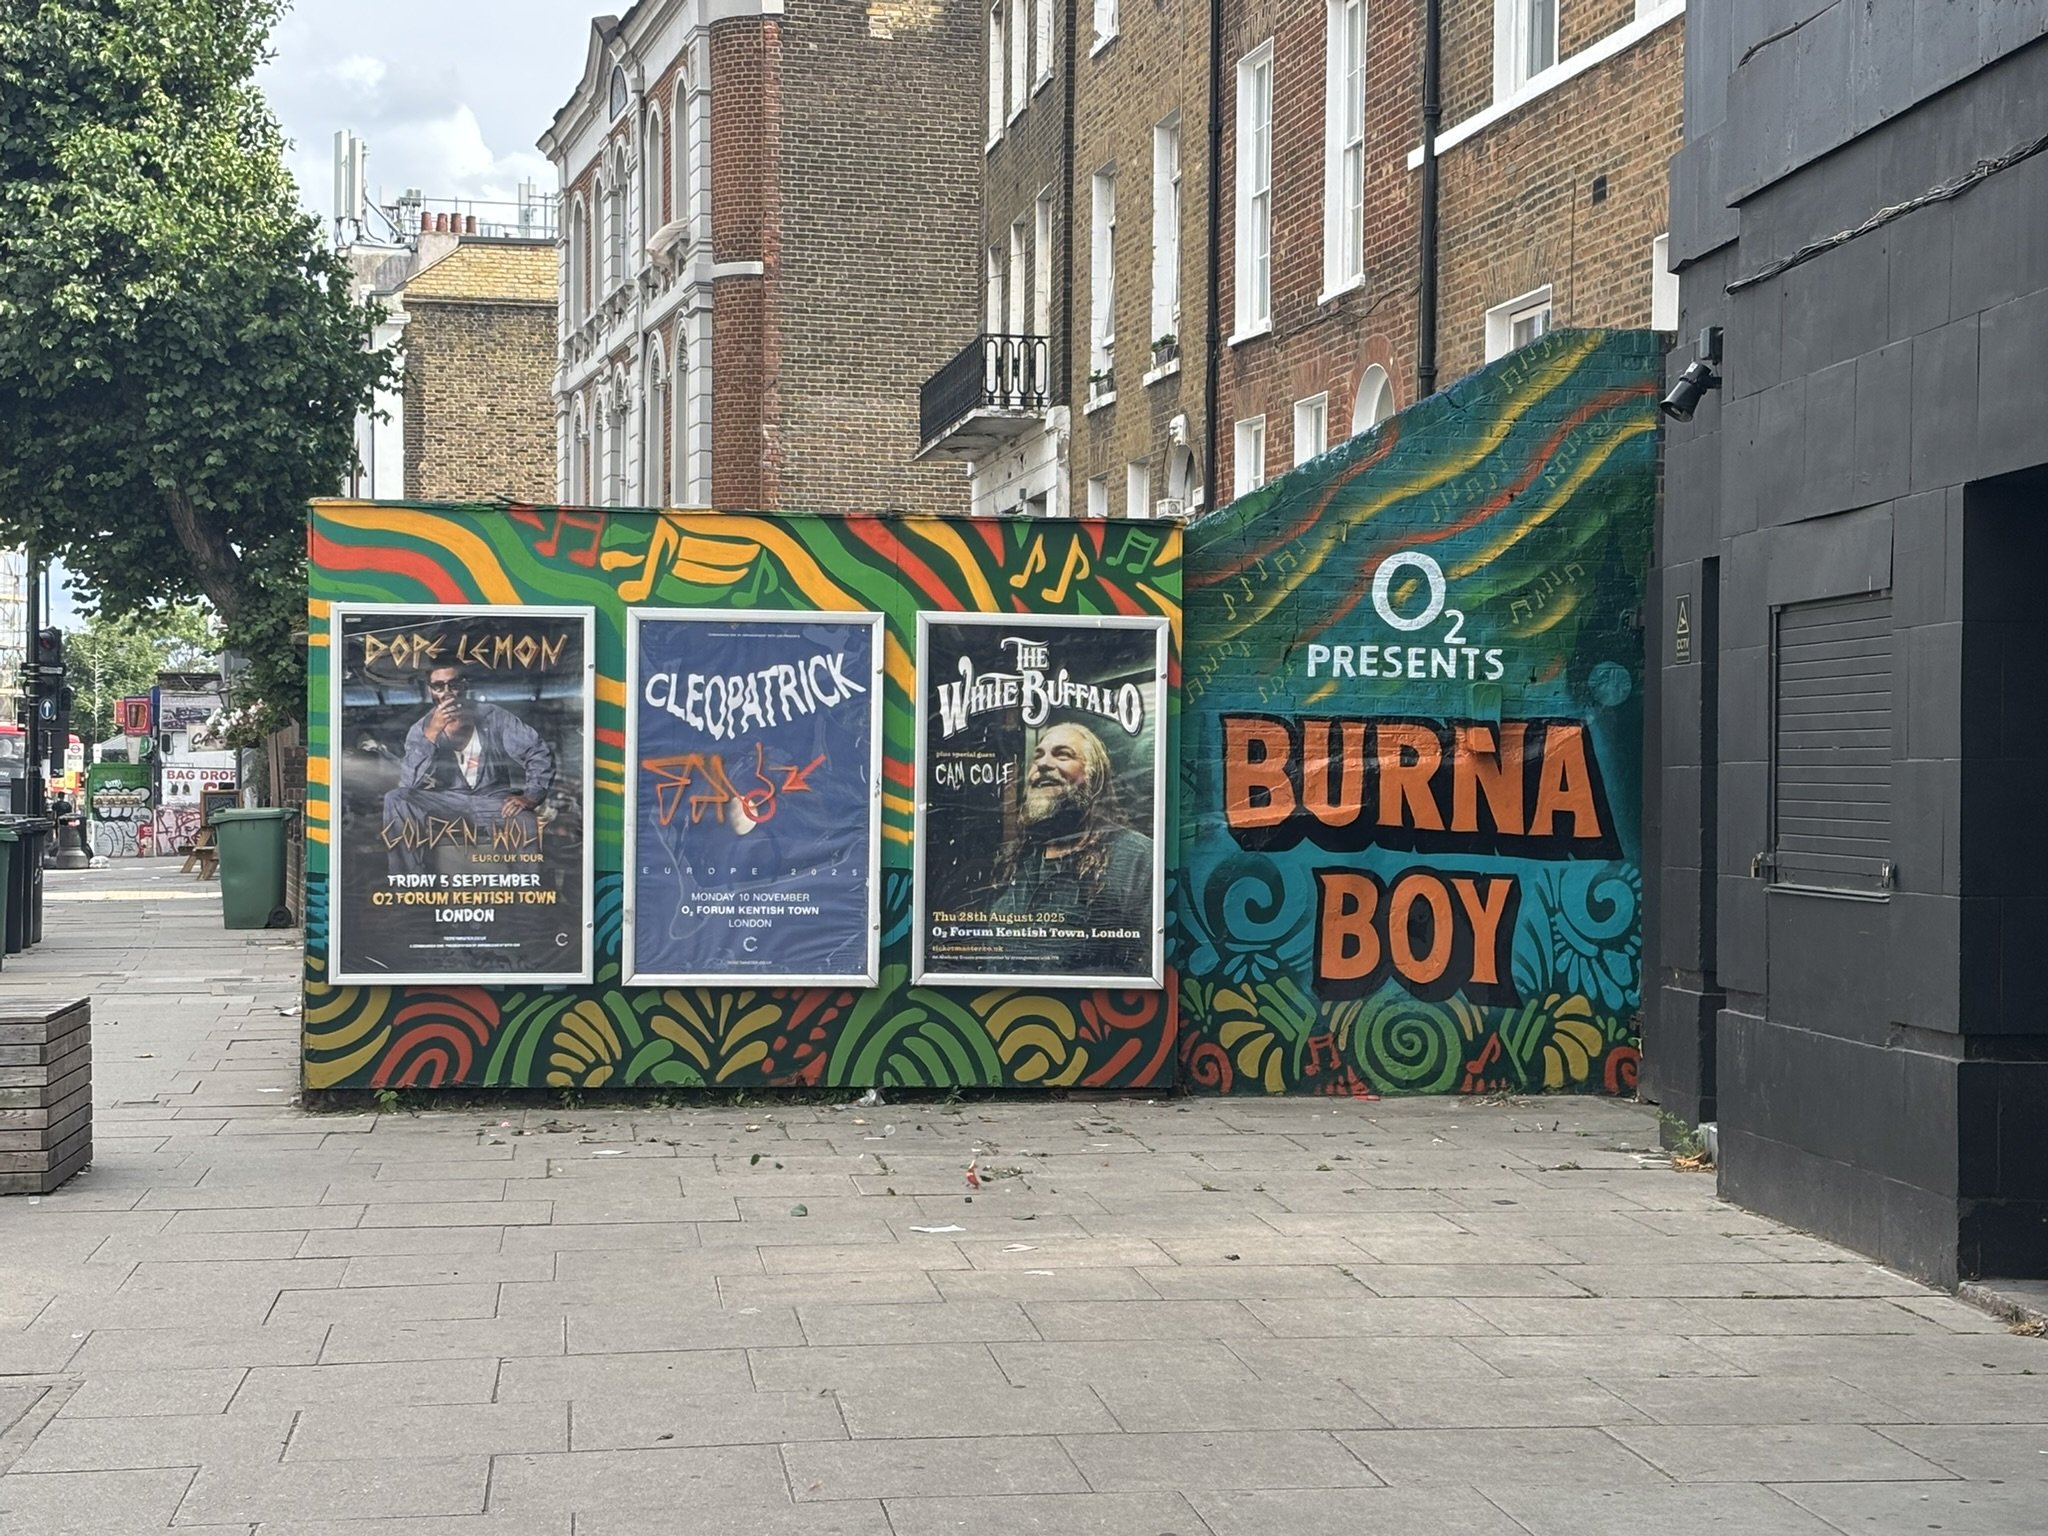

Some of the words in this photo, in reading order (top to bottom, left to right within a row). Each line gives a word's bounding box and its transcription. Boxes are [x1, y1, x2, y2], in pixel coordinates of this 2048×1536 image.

[1372, 550, 1468, 645] O2
[364, 633, 448, 669] DOPE
[456, 633, 568, 672] LEMON
[1001, 636, 1050, 672] THE
[1306, 644, 1505, 681] PRESENTS
[645, 653, 866, 740] CLEOPATRICK
[167, 770, 195, 780] BAG
[200, 770, 237, 780] DROP
[935, 760, 965, 790] CAM
[970, 760, 1016, 786] COLE
[1222, 715, 1604, 840] BURNA
[381, 816, 478, 852] GOLDEN
[492, 816, 549, 851] WOLF
[519, 854, 545, 863] TOUR
[642, 866, 758, 876] EUROPE
[789, 867, 858, 877] 2025
[387, 874, 437, 888] FRIDAY
[440, 874, 449, 888] 5
[452, 874, 541, 888] SEPTEMBER
[372, 892, 394, 906] O2
[395, 892, 449, 906] FORUM
[453, 891, 514, 905] KENTISH
[518, 891, 557, 905] TOWN
[691, 892, 735, 902] MONDAY
[739, 893, 750, 902] 10
[752, 893, 810, 902] NOVEMBER
[435, 908, 495, 922] LONDON
[696, 905, 735, 915] FORUM
[738, 905, 784, 915] KENTISH
[788, 906, 820, 915] TOWN
[728, 919, 772, 928] LONDON
[932, 911, 957, 922] Thu
[959, 911, 987, 922] 28th
[989, 912, 1034, 924] August
[1036, 912, 1065, 923] 2025
[932, 927, 948, 938] O2
[950, 926, 994, 937] Forum
[996, 927, 1047, 938] Kentish
[1049, 927, 1089, 939] Town,
[1091, 928, 1141, 938] London
[1318, 872, 1513, 985] BOY
